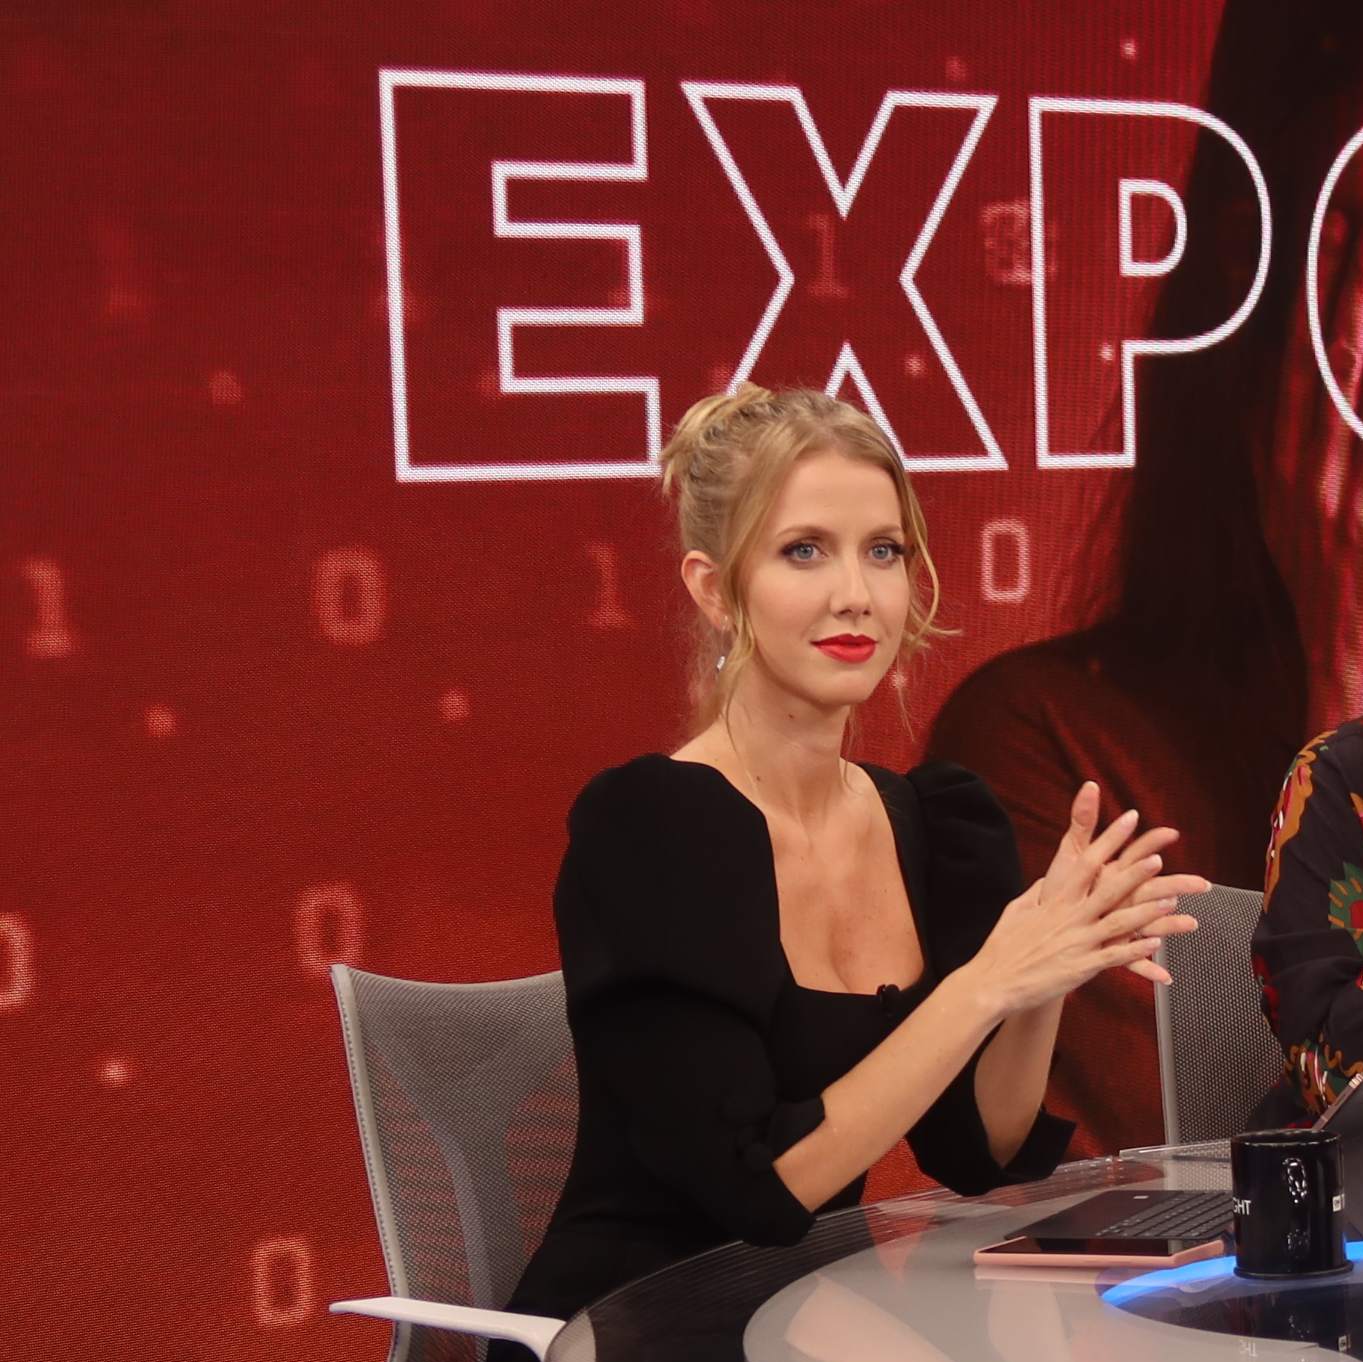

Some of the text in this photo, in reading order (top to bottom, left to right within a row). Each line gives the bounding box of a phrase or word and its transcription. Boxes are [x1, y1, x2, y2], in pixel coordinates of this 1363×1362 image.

[315, 547, 385, 644] 0
[980, 518, 1034, 604] 0
[22, 558, 77, 658] 1
[297, 885, 360, 972] 0
[253, 1236, 312, 1326] 0
